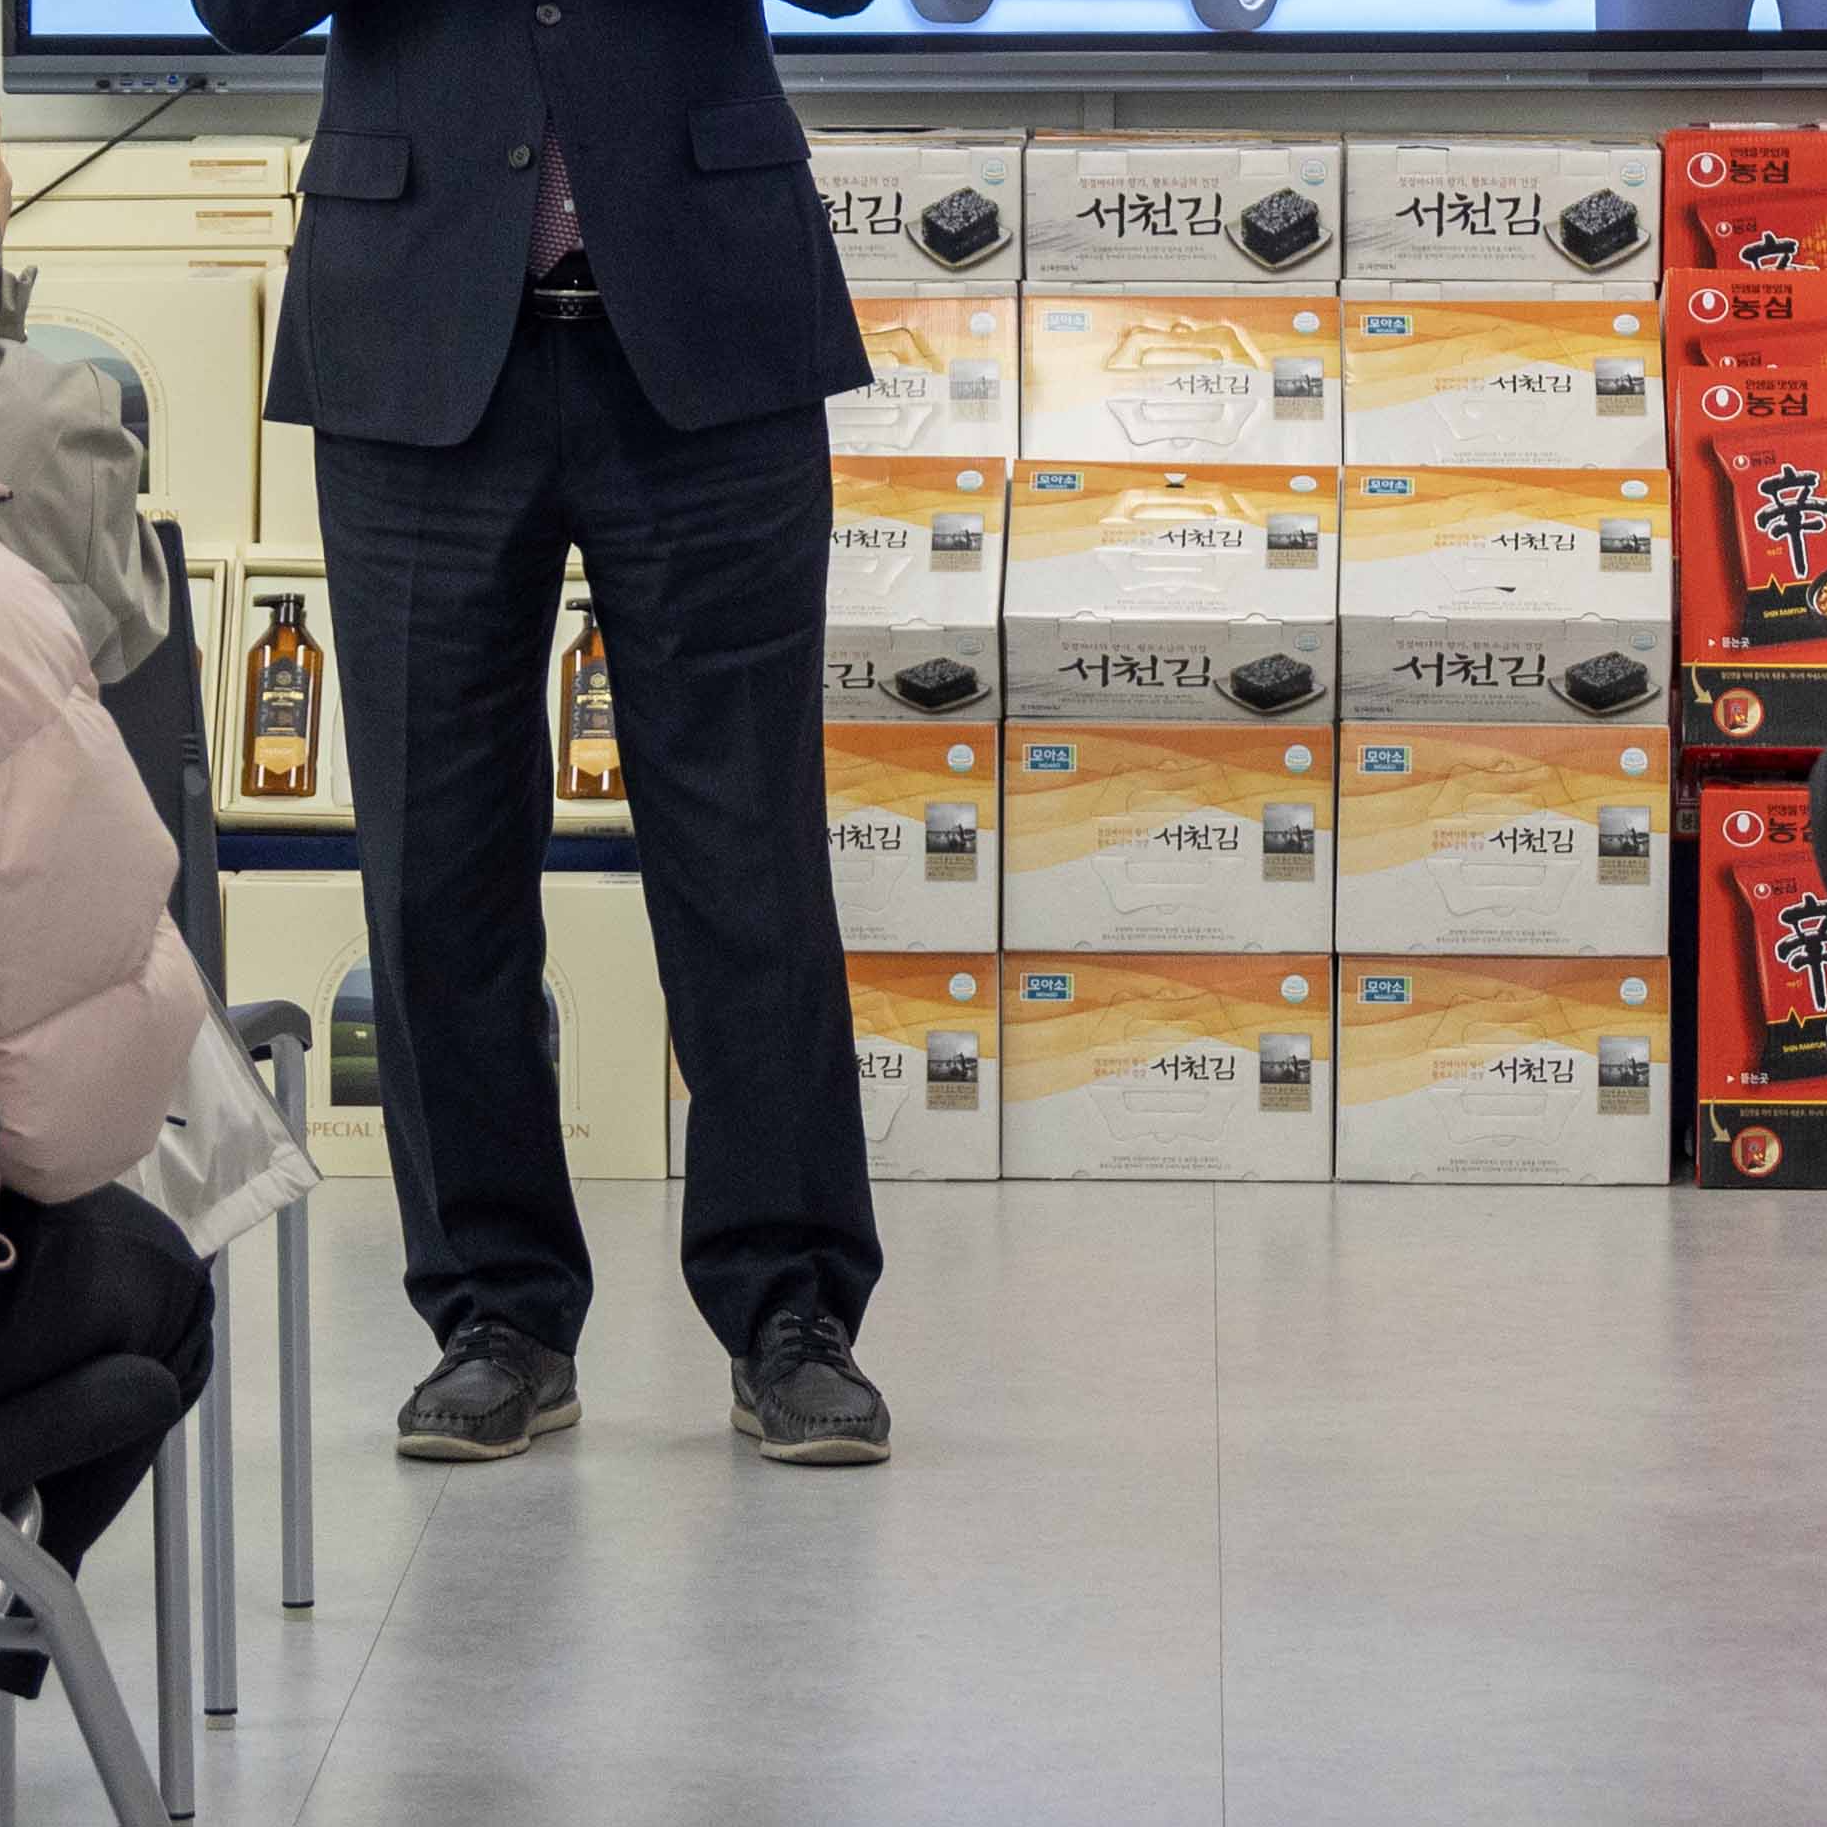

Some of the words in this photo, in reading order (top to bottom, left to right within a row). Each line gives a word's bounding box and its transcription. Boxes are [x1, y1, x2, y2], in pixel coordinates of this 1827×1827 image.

[1730, 160, 1789, 184] 농심
[819, 190, 903, 235] 천김
[1076, 192, 1223, 238] 서천김
[1395, 192, 1541, 238] 서천김
[1732, 296, 1793, 320] 농심
[1166, 374, 1250, 395] 서천김
[1488, 374, 1572, 394] 서천김
[1746, 392, 1808, 417] 농심
[1157, 528, 1243, 549] 서천김
[1490, 532, 1575, 552] 서천김
[1058, 654, 1211, 688] 서천김
[1393, 651, 1546, 688] 서천김
[1032, 748, 1069, 761] 모아소
[1365, 750, 1405, 764] 모아소
[1153, 824, 1239, 851] 서천김
[1488, 827, 1574, 854] 서천김
[1029, 976, 1068, 990] 모아소
[1366, 979, 1405, 993] 모아소
[856, 1051, 903, 1079] 천김
[1149, 1054, 1236, 1081] 서천김
[1488, 1057, 1574, 1084] 서천김
